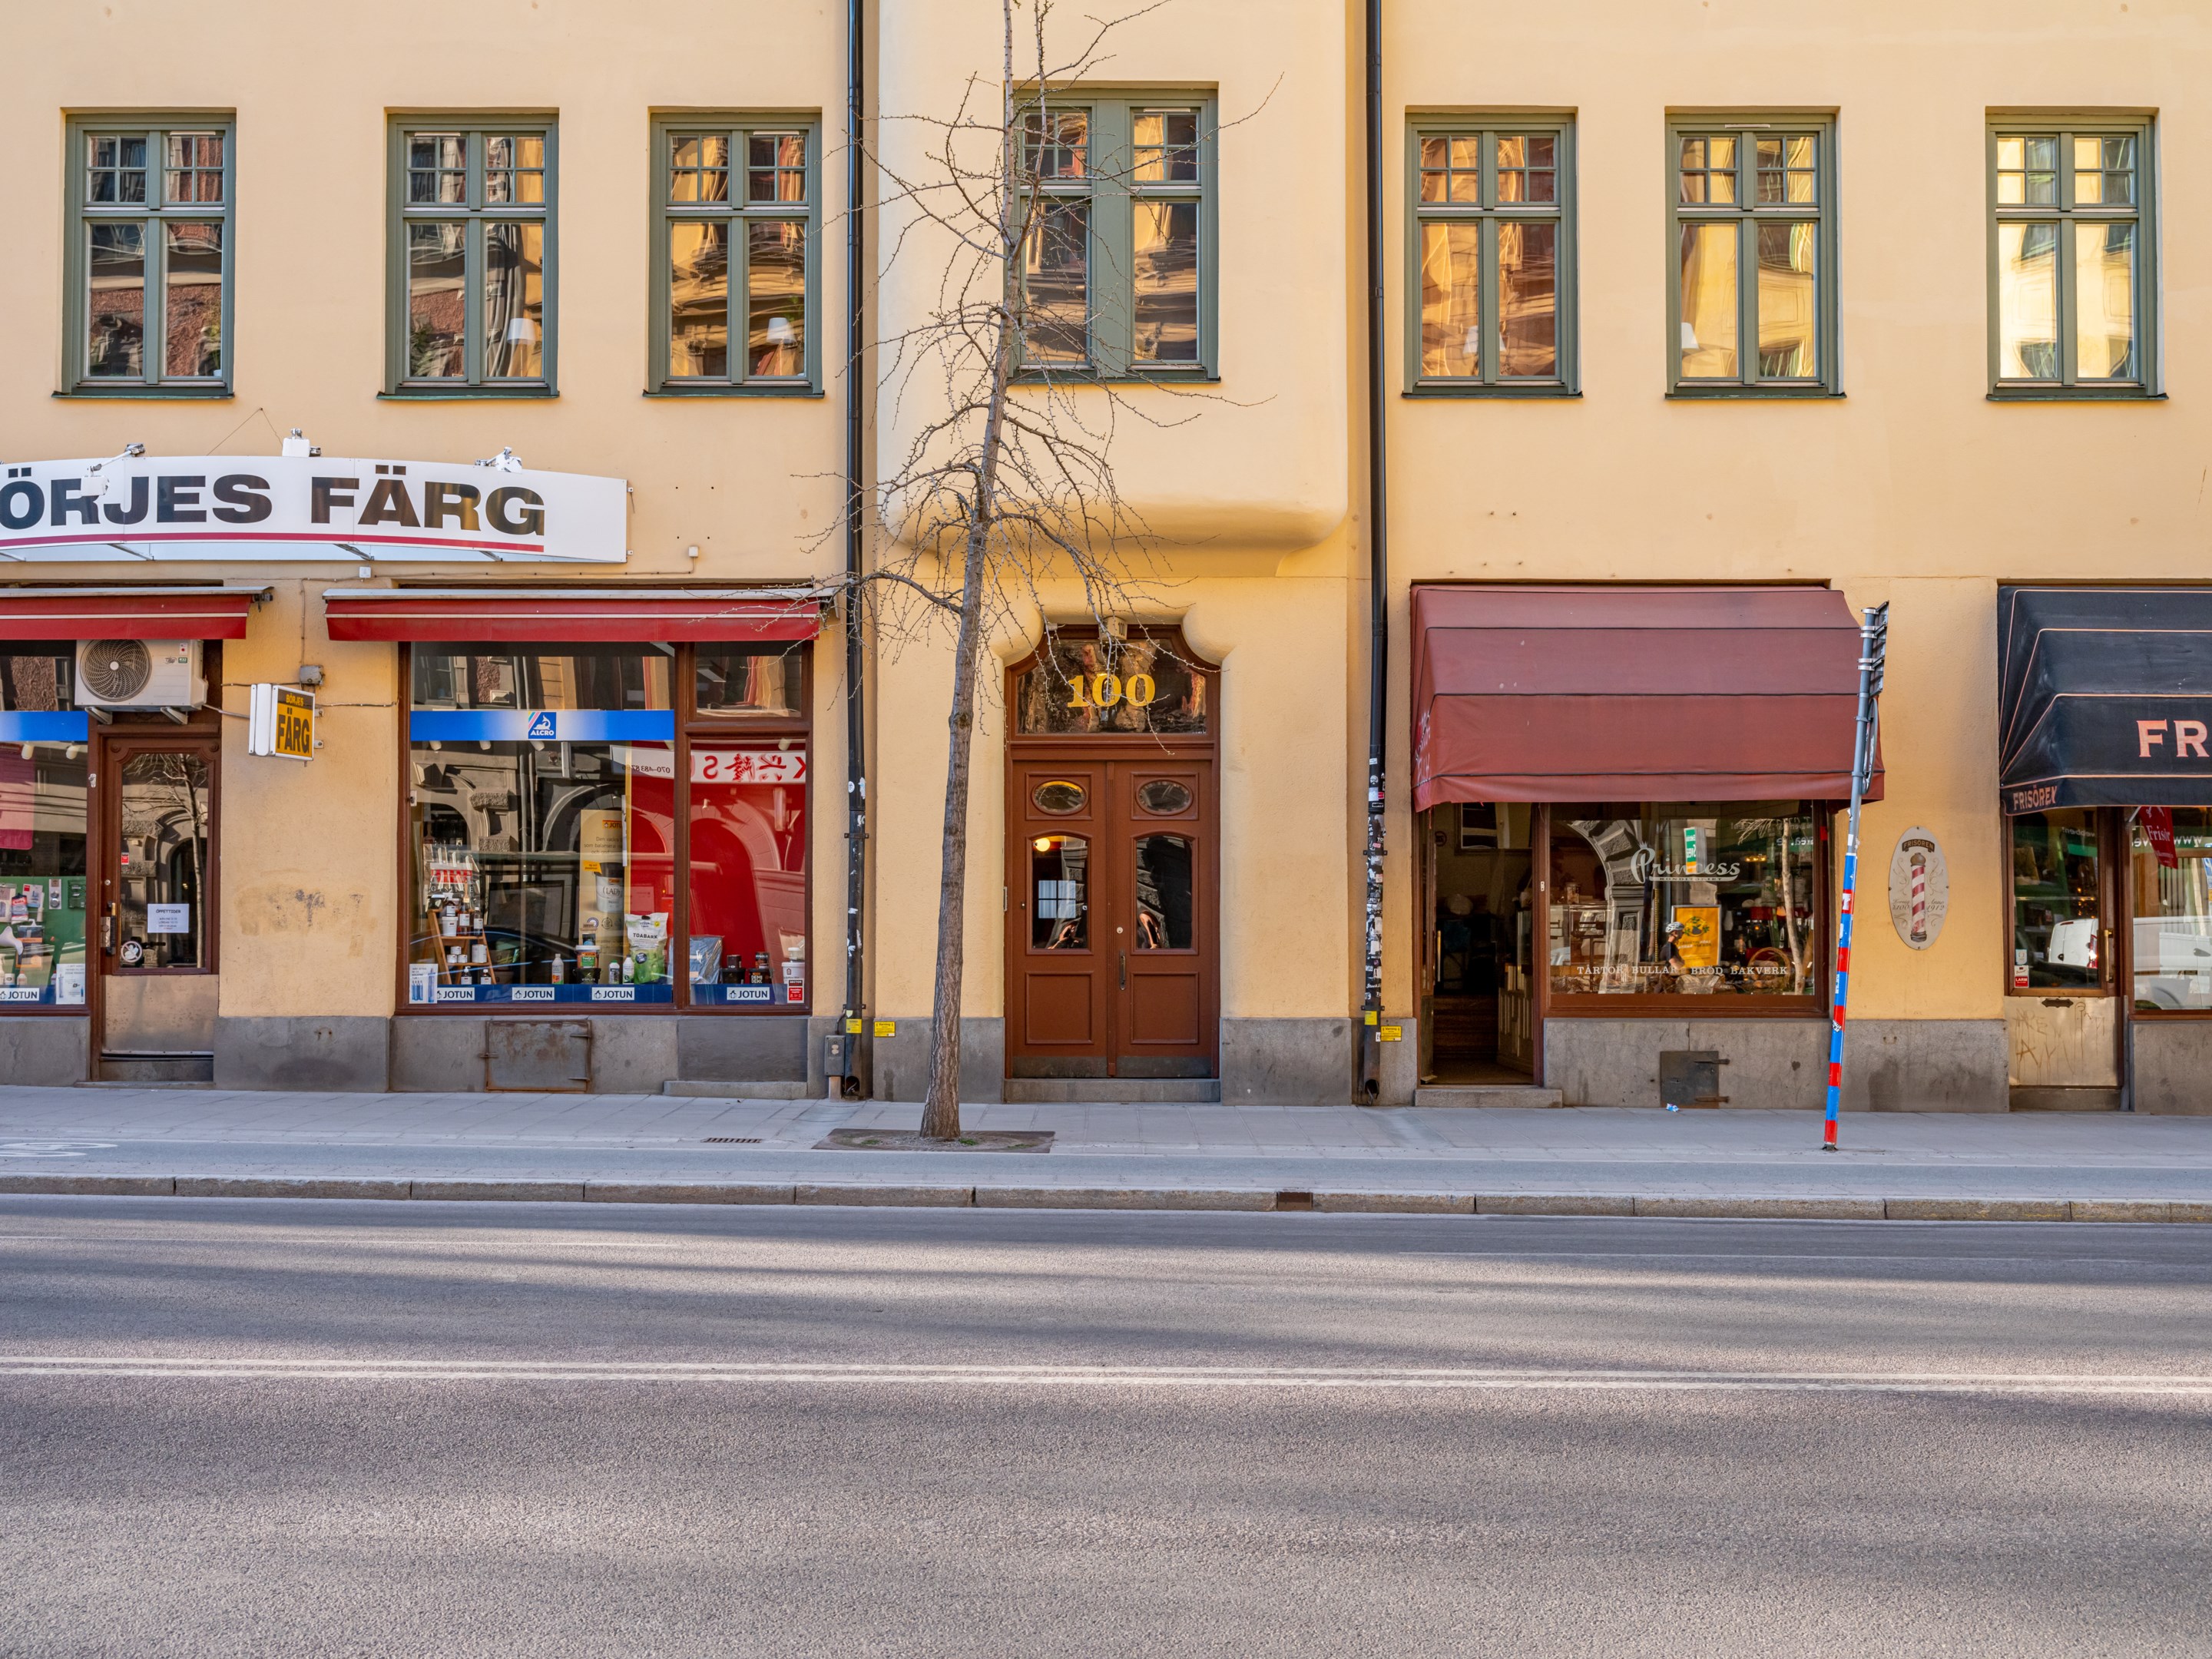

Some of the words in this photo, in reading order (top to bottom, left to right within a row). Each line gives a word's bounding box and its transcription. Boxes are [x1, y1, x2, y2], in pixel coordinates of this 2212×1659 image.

[0, 467, 273, 530] ÖRJES
[311, 465, 545, 536] FÄRG
[1068, 674, 1155, 707] 100
[286, 693, 304, 707] BÖRJES
[277, 707, 310, 753] FÄRG
[2136, 719, 2210, 757] FR
[1631, 846, 1740, 883] Princess
[1577, 965, 1623, 975] TÅRTOR
[1690, 965, 1724, 975] BRÖD
[1730, 966, 1788, 975] BAKVERK
[8, 991, 38, 999] JOTUN
[442, 990, 473, 998] JOTUN
[523, 990, 553, 998] JOTUN
[603, 990, 633, 998] JOTUN
[738, 990, 768, 998] JOTUN
